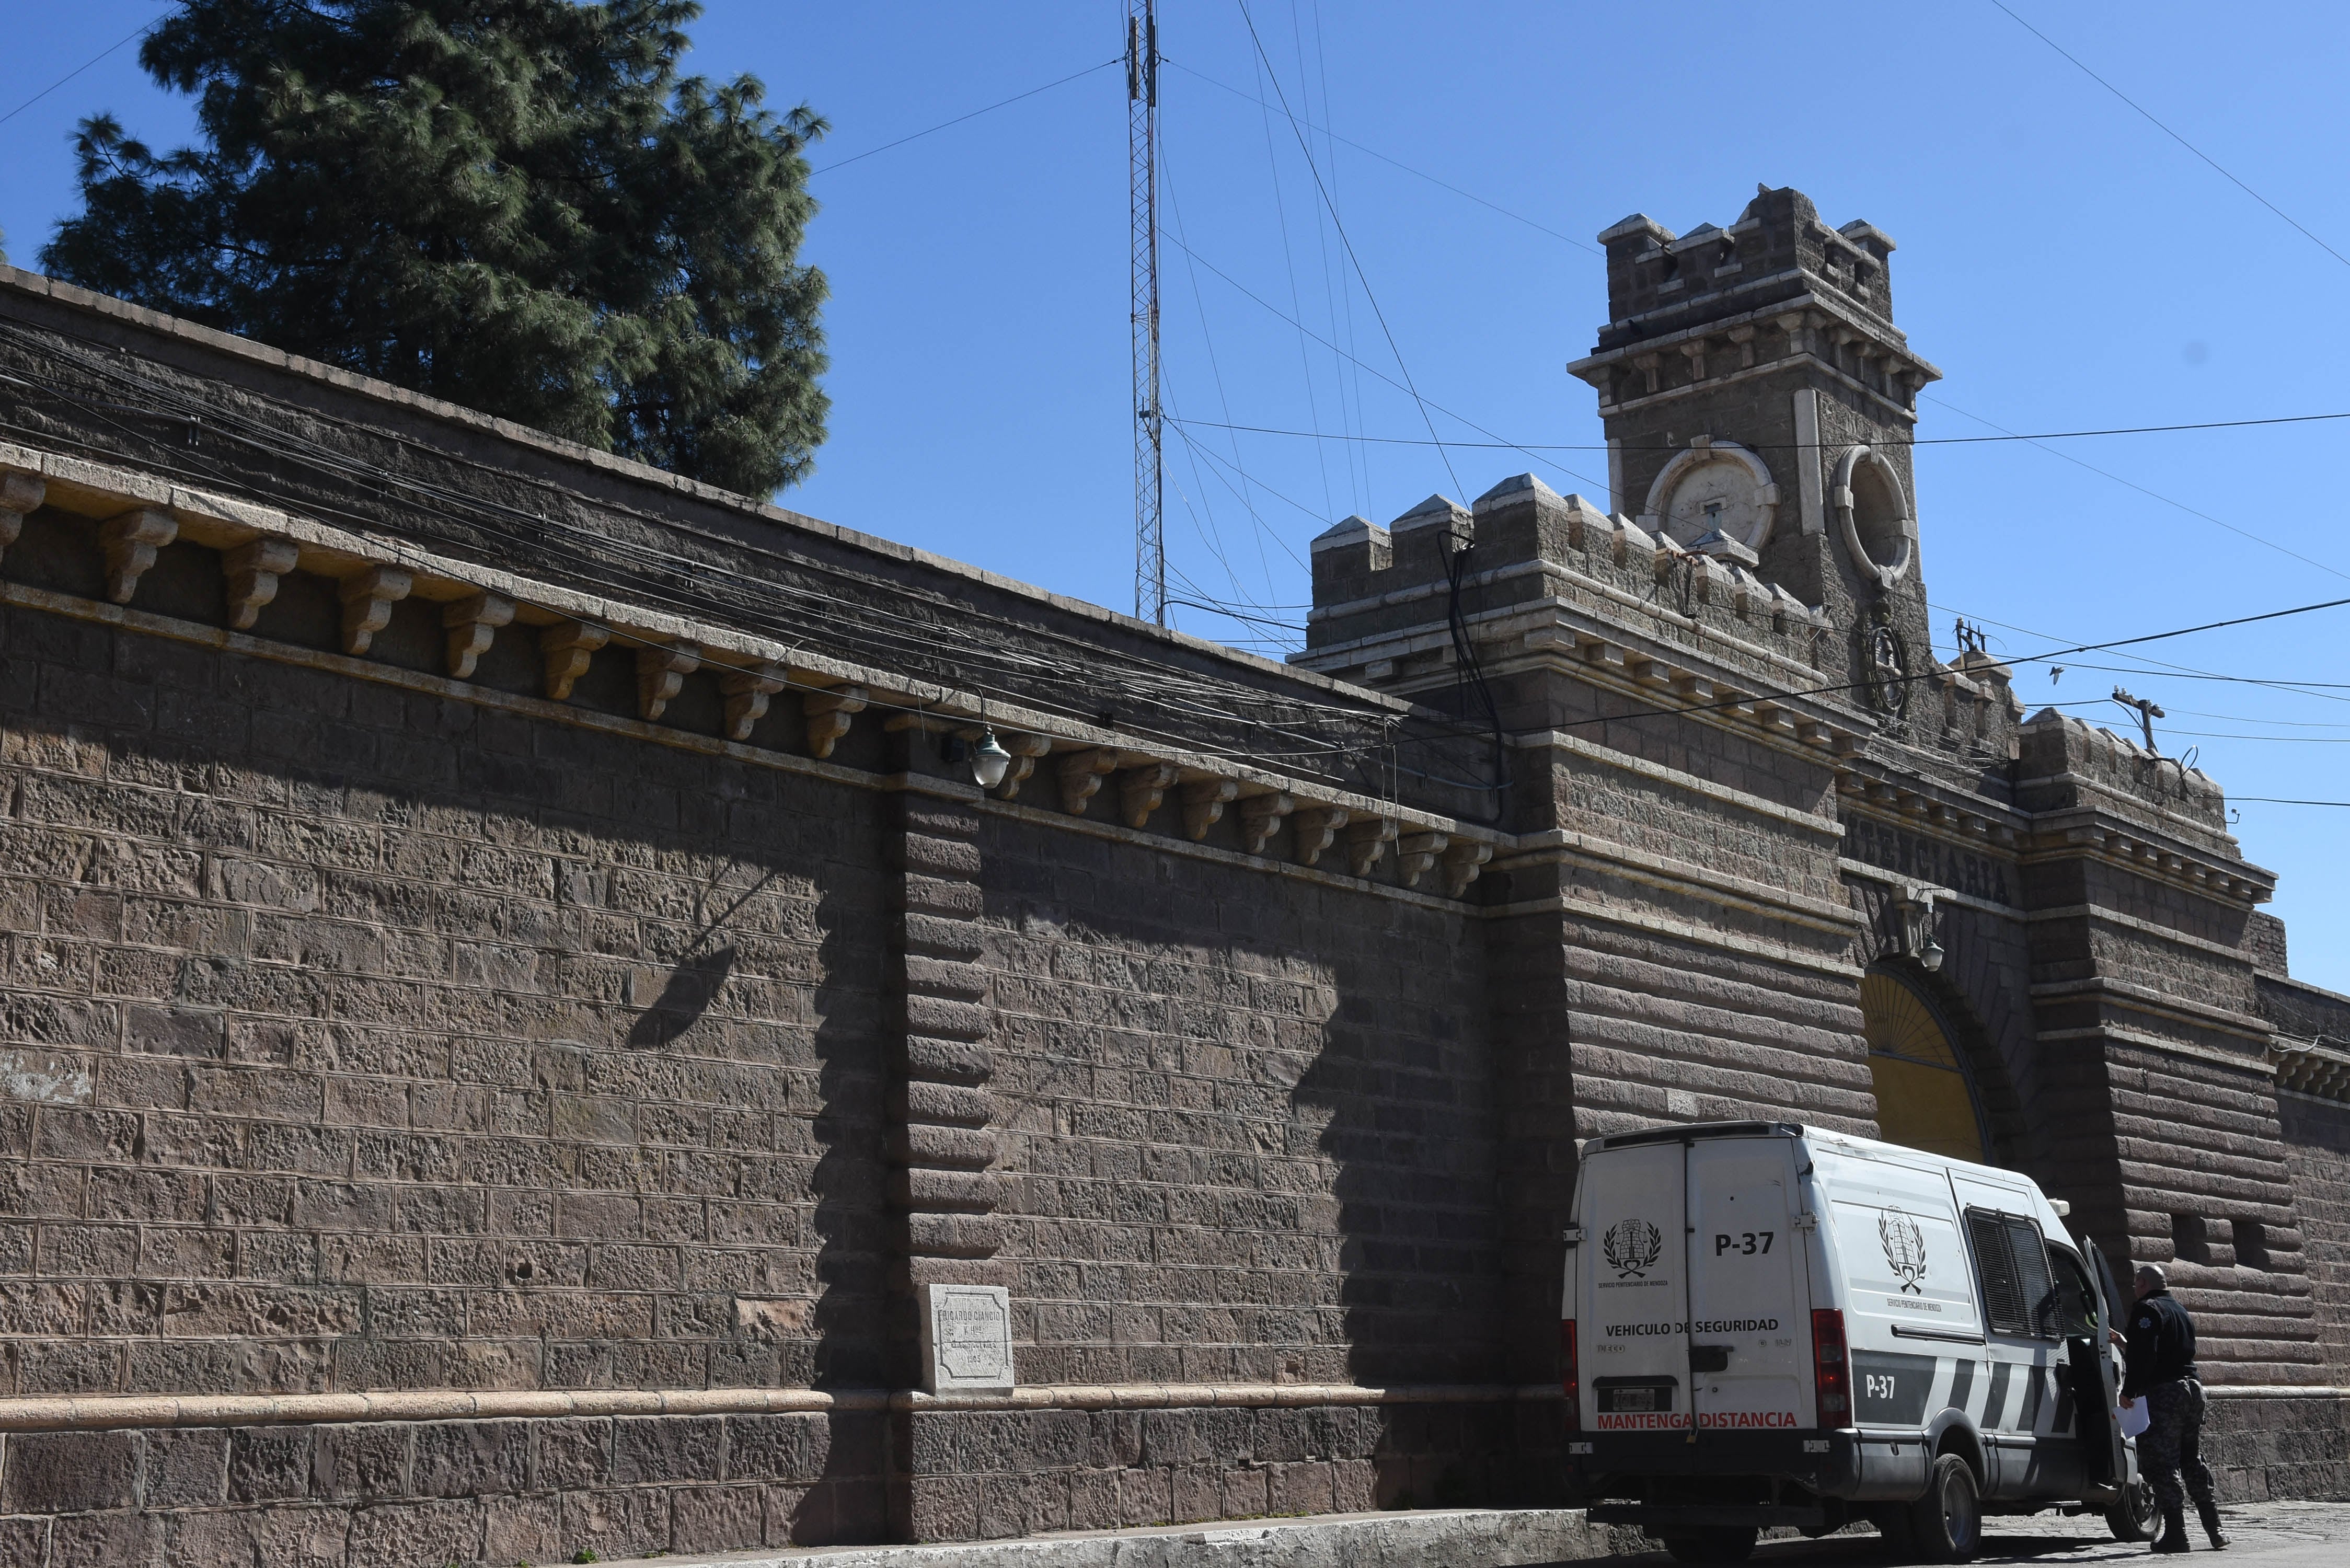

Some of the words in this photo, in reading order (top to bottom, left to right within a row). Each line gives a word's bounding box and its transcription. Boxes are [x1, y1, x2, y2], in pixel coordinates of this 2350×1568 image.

[1716, 1231, 1774, 1256] P-37
[1887, 1298, 1901, 1308] SERVICIO
[1901, 1300, 1923, 1310] PENITENCIARIO
[1927, 1303, 1942, 1312] MENDOZA
[942, 1310, 972, 1321] RICARDO
[973, 1310, 1000, 1321] CIANCIO
[1606, 1322, 1671, 1337] VEHICULO
[1675, 1322, 1689, 1334] DE
[1695, 1319, 1779, 1333] SEGURIDAD
[967, 1355, 981, 1363] 1905
[1867, 1374, 1895, 1399] P-37
[1597, 1413, 1694, 1429] MANTENGA
[1699, 1412, 1798, 1428] DISTANCIA
